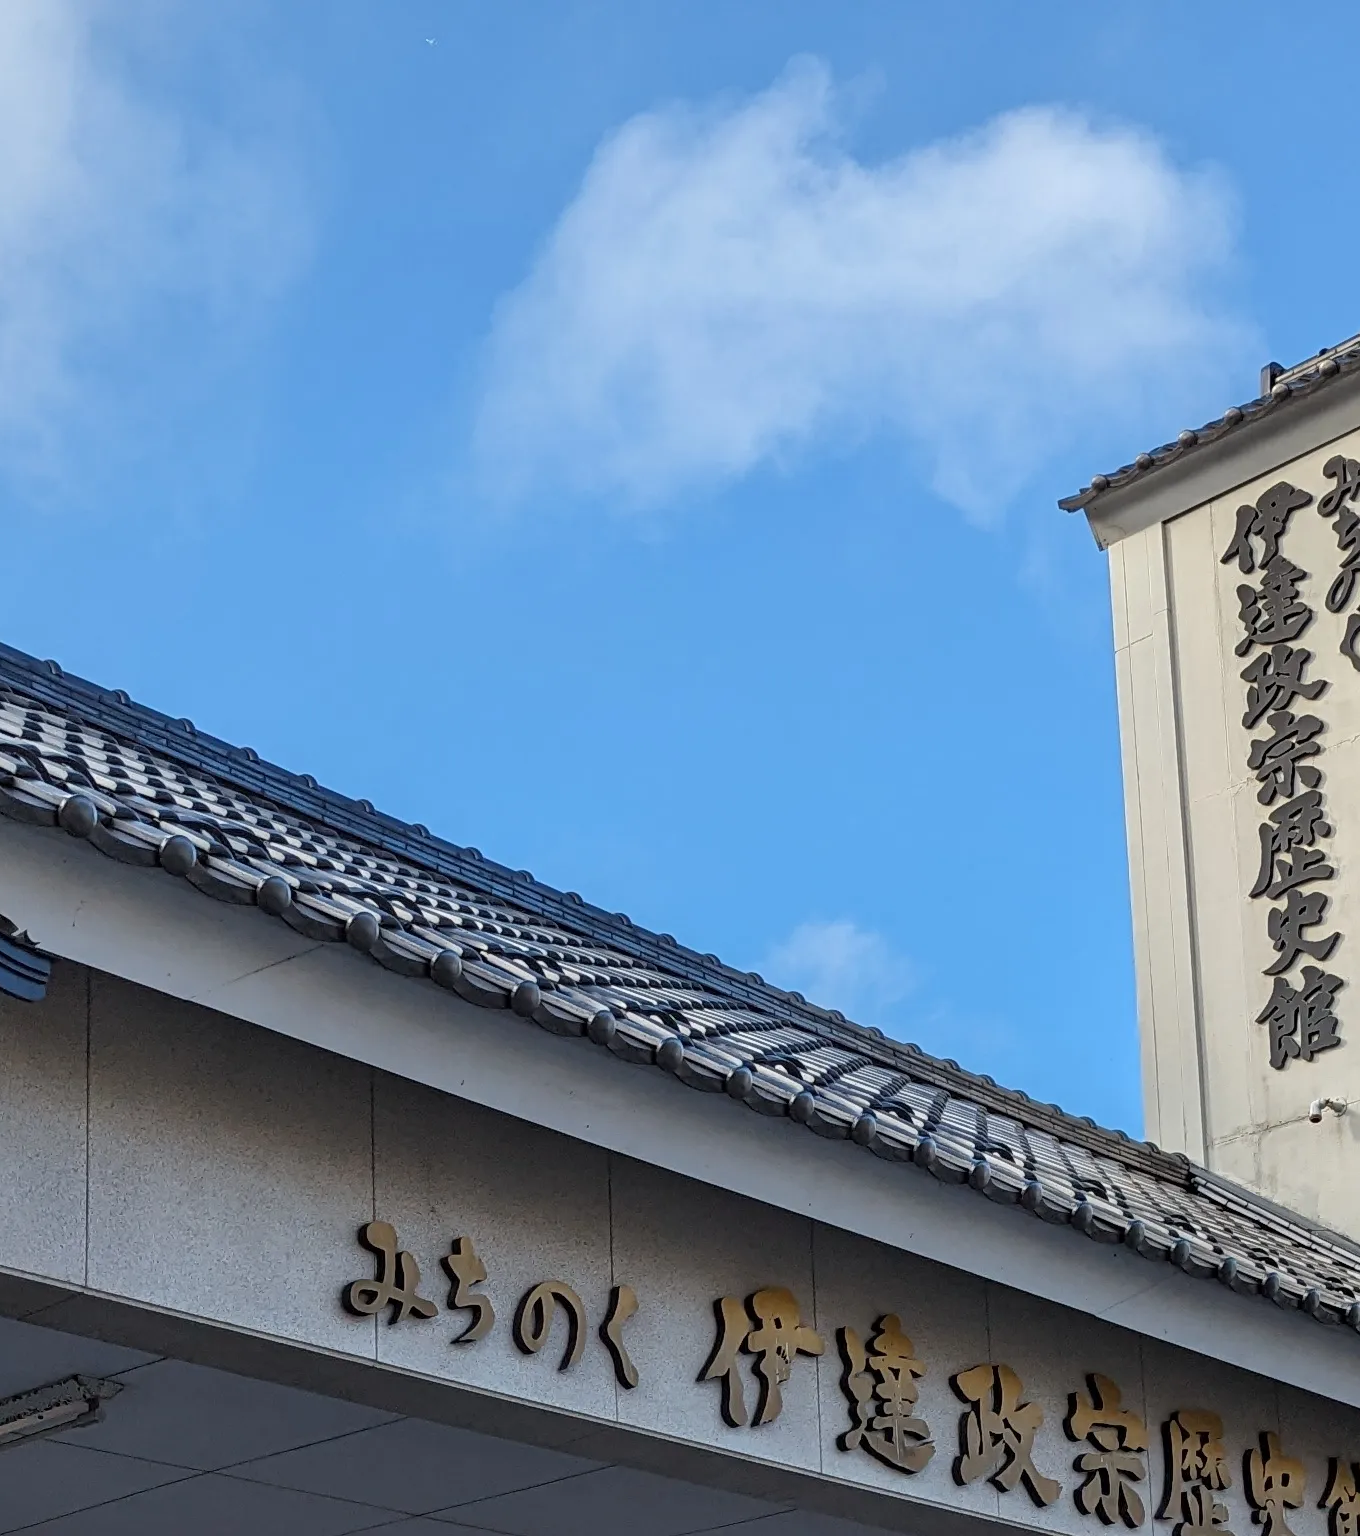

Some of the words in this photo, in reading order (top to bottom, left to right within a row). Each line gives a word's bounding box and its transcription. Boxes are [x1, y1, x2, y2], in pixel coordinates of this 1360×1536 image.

[1221, 481, 1344, 1069] 伊達政宗歴史館
[341, 1221, 639, 1390] みちのく
